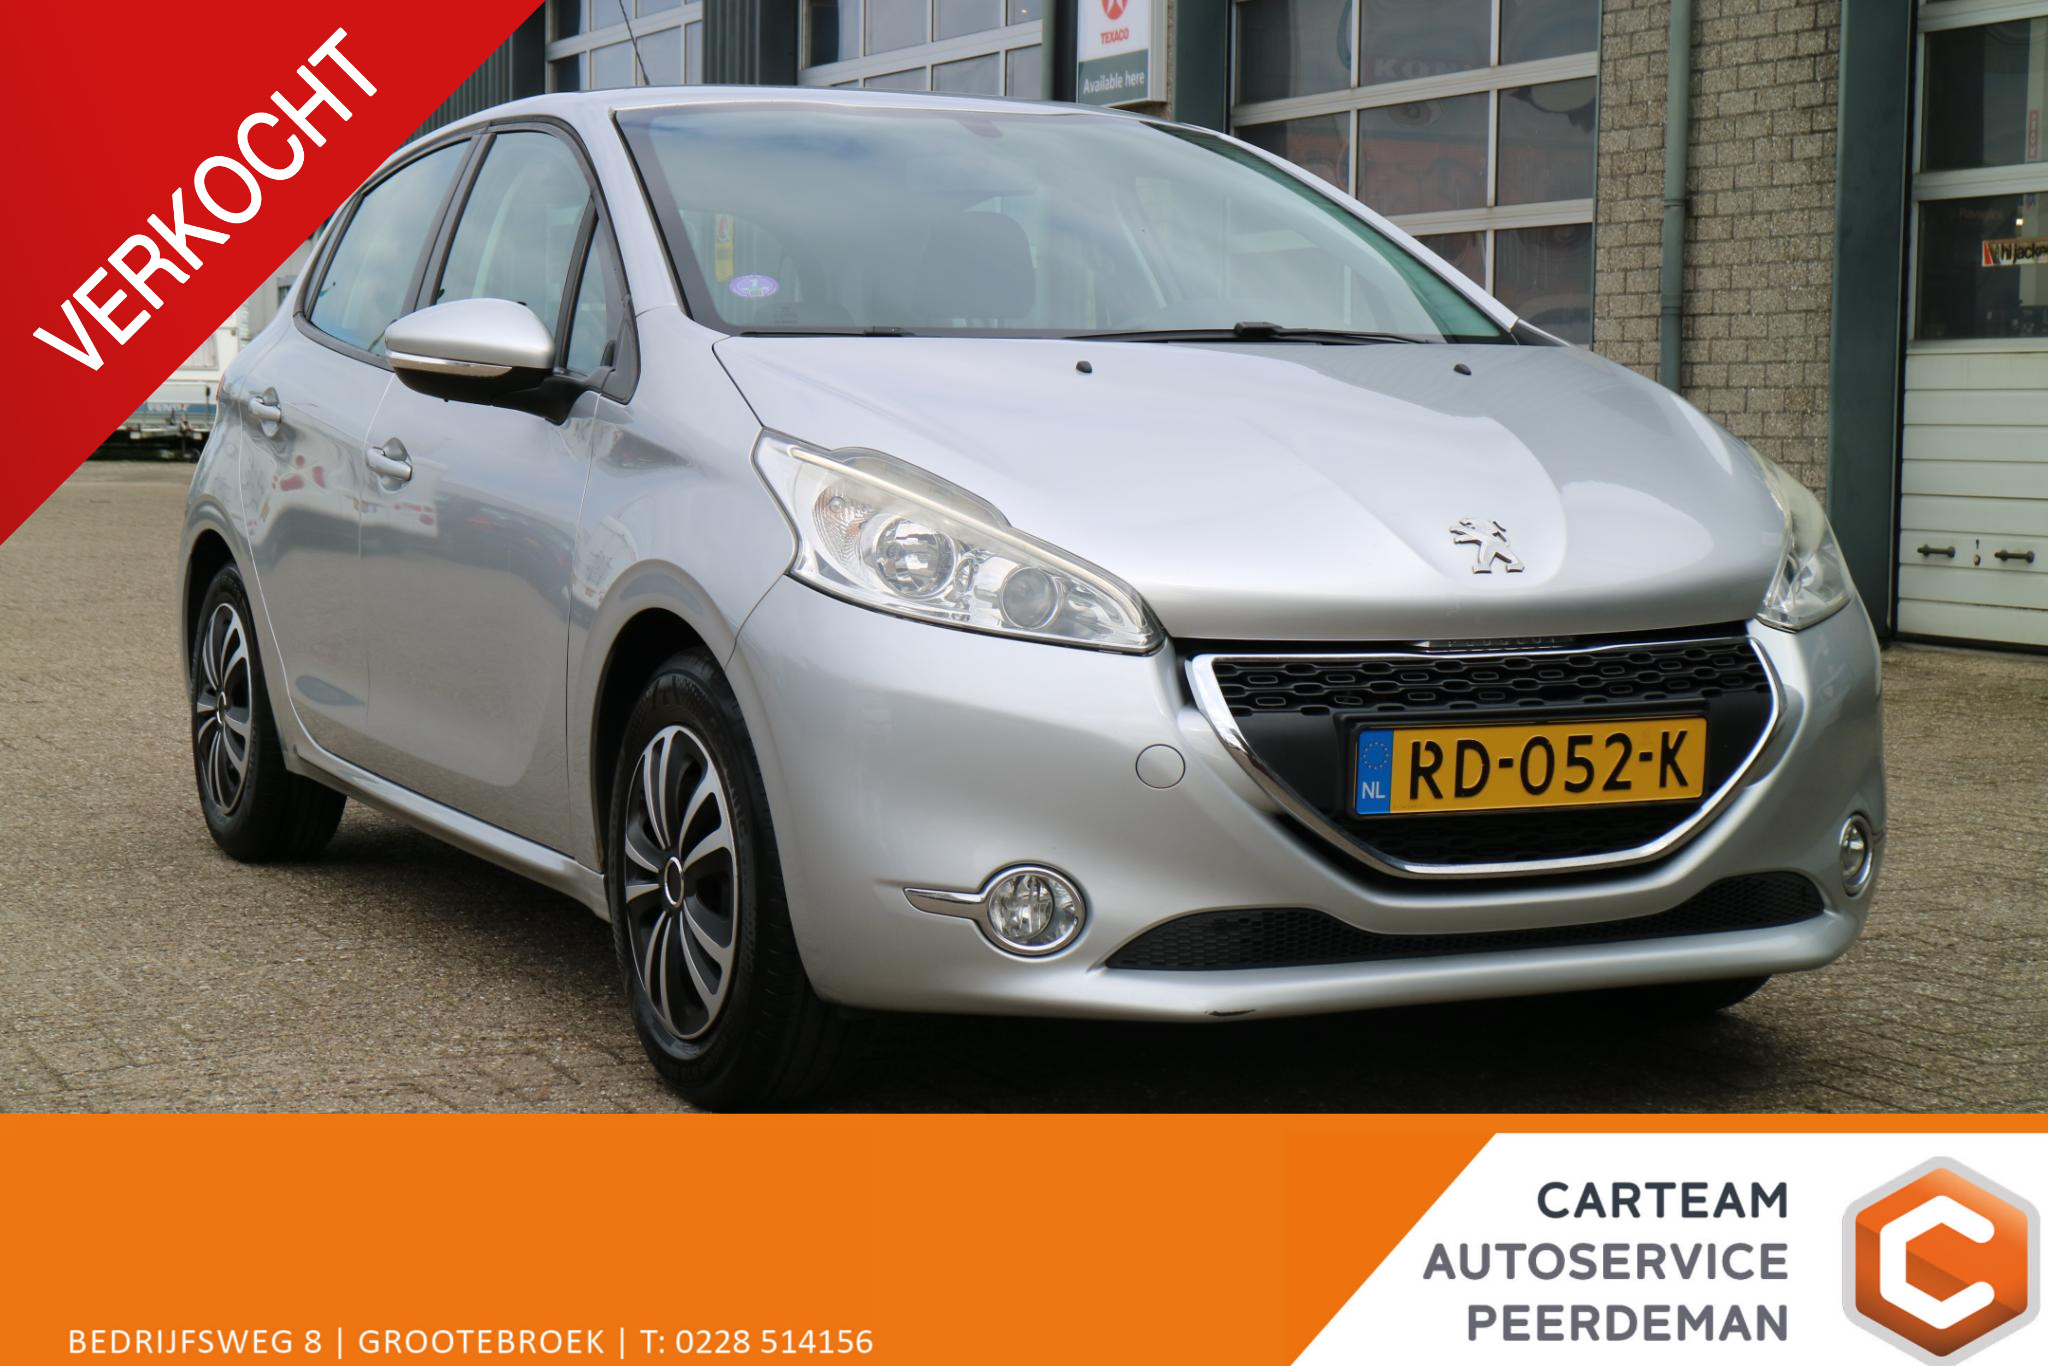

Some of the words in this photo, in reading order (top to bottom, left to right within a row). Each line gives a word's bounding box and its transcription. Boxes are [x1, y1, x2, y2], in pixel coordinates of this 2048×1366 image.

[1100, 27, 1130, 45] TEXACO
[1083, 72, 1123, 95] Available
[1124, 70, 1145, 88] here
[1409, 730, 1689, 800] RD-052-K
[1361, 781, 1386, 800] NL
